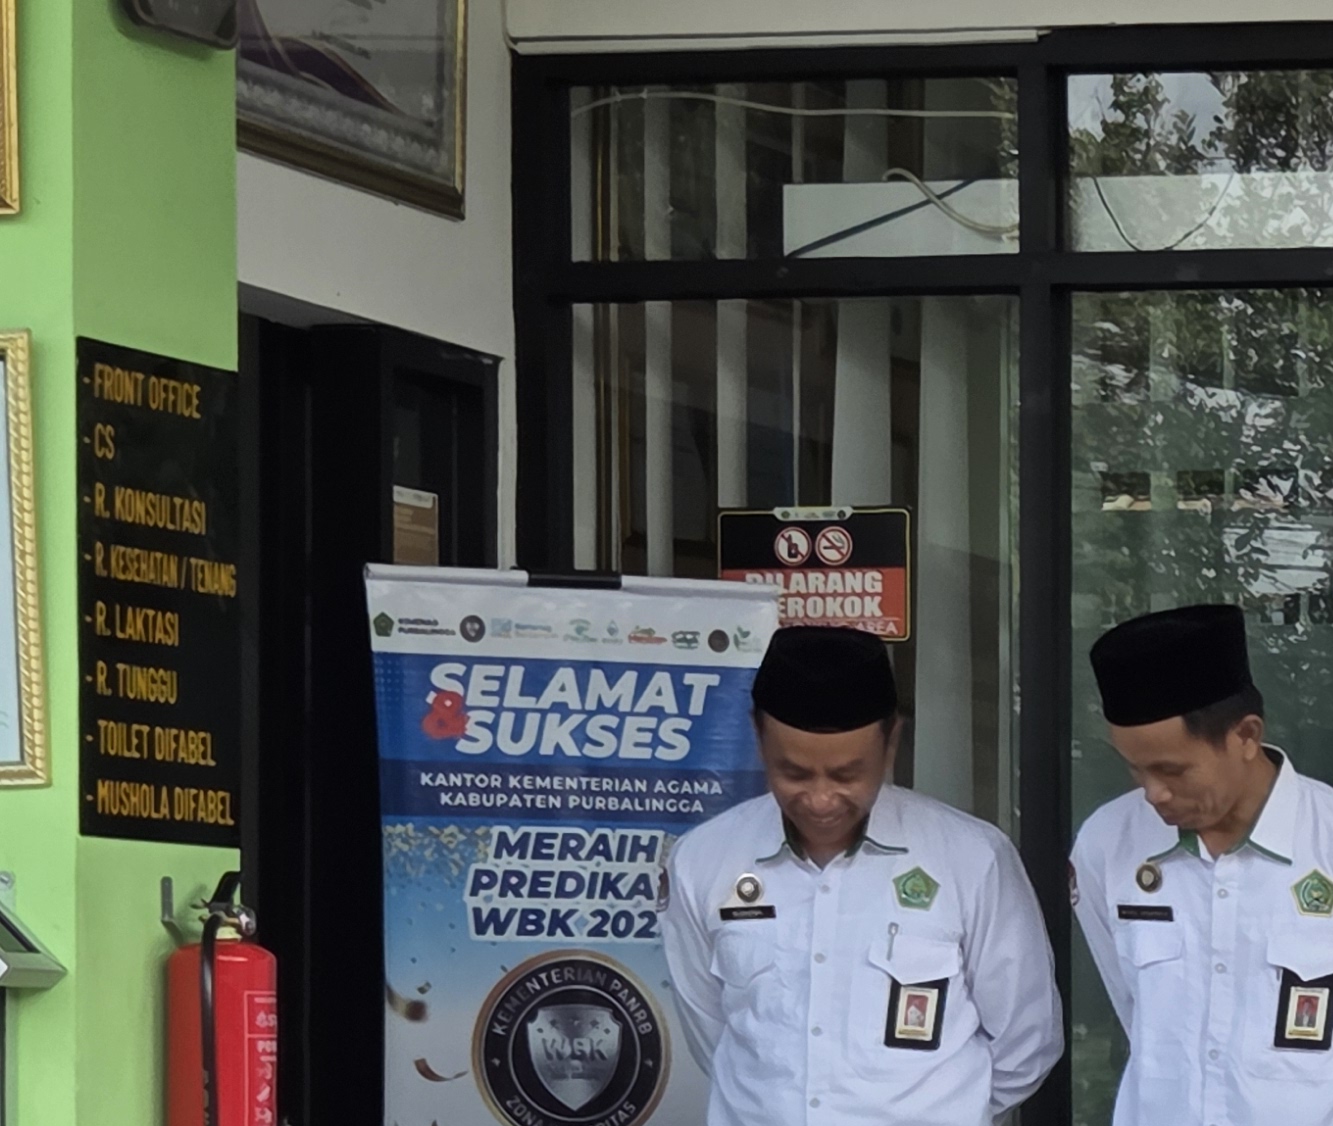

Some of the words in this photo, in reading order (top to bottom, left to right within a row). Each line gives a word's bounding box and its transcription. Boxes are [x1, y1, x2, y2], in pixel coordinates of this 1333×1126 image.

[94, 363, 145, 408] FRONT
[148, 375, 201, 420] OFFICE
[94, 423, 115, 460] CS
[94, 482, 111, 518] R.
[115, 486, 207, 536] KONSULTASI
[94, 542, 109, 577] R.
[111, 545, 178, 589] KESEHATAN
[191, 557, 236, 598] TENANG
[95, 602, 111, 636] R.
[115, 607, 179, 648] LAKTASI
[778, 596, 883, 618] EROKOK
[96, 661, 112, 696] R.
[116, 663, 177, 704] TUNGGU
[430, 662, 721, 716] SELAMAT
[421, 690, 469, 740] &
[455, 710, 692, 761] SUKSES
[97, 719, 151, 760] TOILET
[154, 724, 217, 767] DIFABEL
[97, 780, 171, 821] MUSHOLA
[174, 787, 234, 826] DIFABEL
[420, 772, 502, 788] KANTOR
[508, 775, 648, 793] KEMENTERIAN
[653, 778, 723, 795] AGAMA
[440, 792, 562, 809] KABUPATEN
[568, 796, 704, 813] PURBALINGGA
[492, 831, 659, 863] MERAIH
[471, 907, 580, 937] WBK
[586, 909, 659, 939] 202
[492, 966, 607, 1035] KEMENTERIAN
[608, 977, 654, 1036] PANRB
